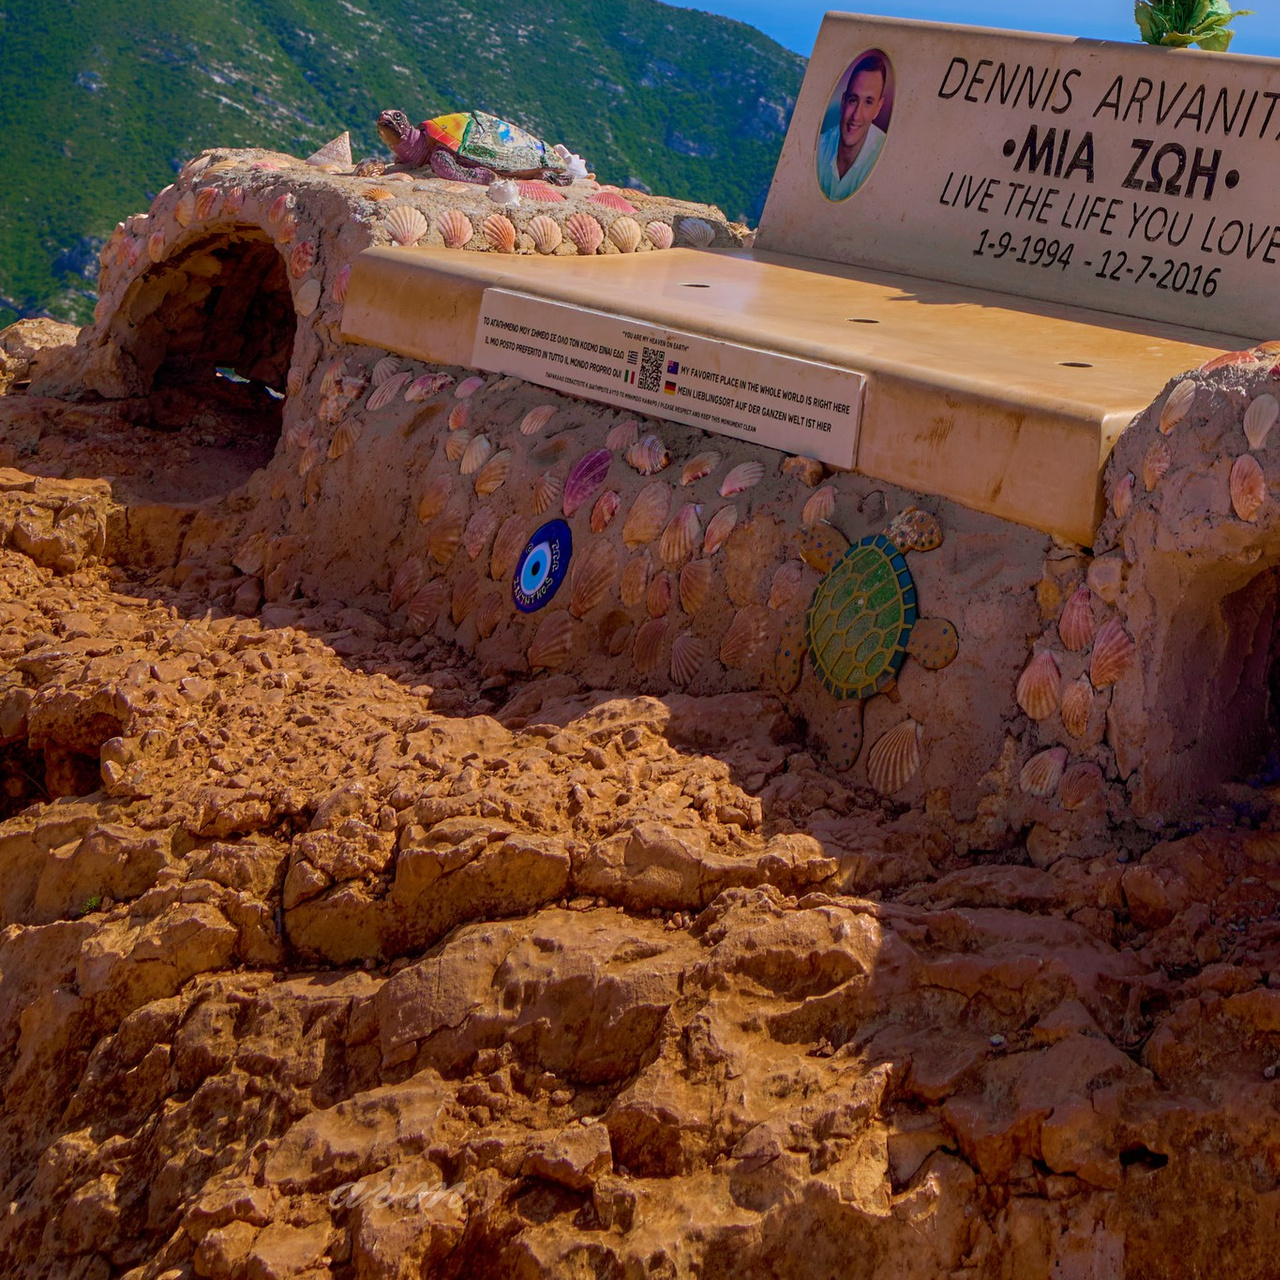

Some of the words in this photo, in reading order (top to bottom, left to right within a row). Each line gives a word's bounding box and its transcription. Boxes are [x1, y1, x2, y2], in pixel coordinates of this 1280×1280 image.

[937, 56, 1082, 114] DENNIS
[939, 171, 1001, 213] LIVE
[1004, 181, 1060, 224] THE
[1060, 192, 1123, 235] LIFE
[1128, 202, 1194, 247] YOU
[973, 228, 1075, 271] 1-9-1994
[483, 316, 489, 326] ΤΟ
[490, 319, 519, 333] ΑΓΑΠΗΜΕΝΟ
[519, 326, 530, 336] ΜΟΥ
[531, 328, 549, 340] ΣΗΜΕΙΟ
[549, 333, 557, 342] ΣΕ
[557, 335, 569, 345] ΟΛΟ
[569, 337, 580, 348] ΤΟΝ
[580, 339, 599, 353] ΚΟΣΜΟ
[598, 344, 613, 356] ΕΙΝΑΙ
[612, 349, 625, 359] ΕΔΩ
[485, 336, 490, 344] IL
[490, 337, 499, 347] MIO
[499, 339, 515, 351] POSTO
[516, 343, 542, 358] PREFERITO
[542, 350, 548, 359] IN
[548, 352, 564, 364] TUTTO
[564, 357, 569, 365] IL
[570, 357, 589, 370] MONDO
[589, 361, 612, 376] PROPRIO
[612, 368, 622, 378] QUI
[642, 335, 650, 343] MY
[649, 337, 667, 347] HEAVEN
[677, 386, 692, 398] MEIN
[692, 389, 734, 409] LIEBLINGSORT
[735, 400, 748, 412] AUF
[748, 403, 761, 415] DER
[761, 406, 787, 422] GANZEN
[788, 413, 805, 427] WELT
[805, 417, 817, 429] IST
[817, 420, 832, 433] HIER
[681, 365, 690, 375] MY
[690, 368, 720, 384] FAVORITE
[720, 375, 739, 388] PLACE
[739, 381, 747, 390] IN
[747, 382, 759, 393] THE
[759, 384, 781, 399] WHOLE
[782, 389, 805, 404] WORLD
[805, 395, 812, 406] IS
[813, 397, 832, 411] RIGHT
[832, 402, 851, 415] HERE
[660, 402, 675, 412] PLEASE
[675, 405, 692, 416] RESPECT
[692, 410, 701, 418] AND
[700, 412, 711, 421] KEEP
[720, 418, 743, 429] MONUMENT
[743, 423, 757, 433] CLEAN
[514, 576, 553, 605] ZAKYNTHOS
